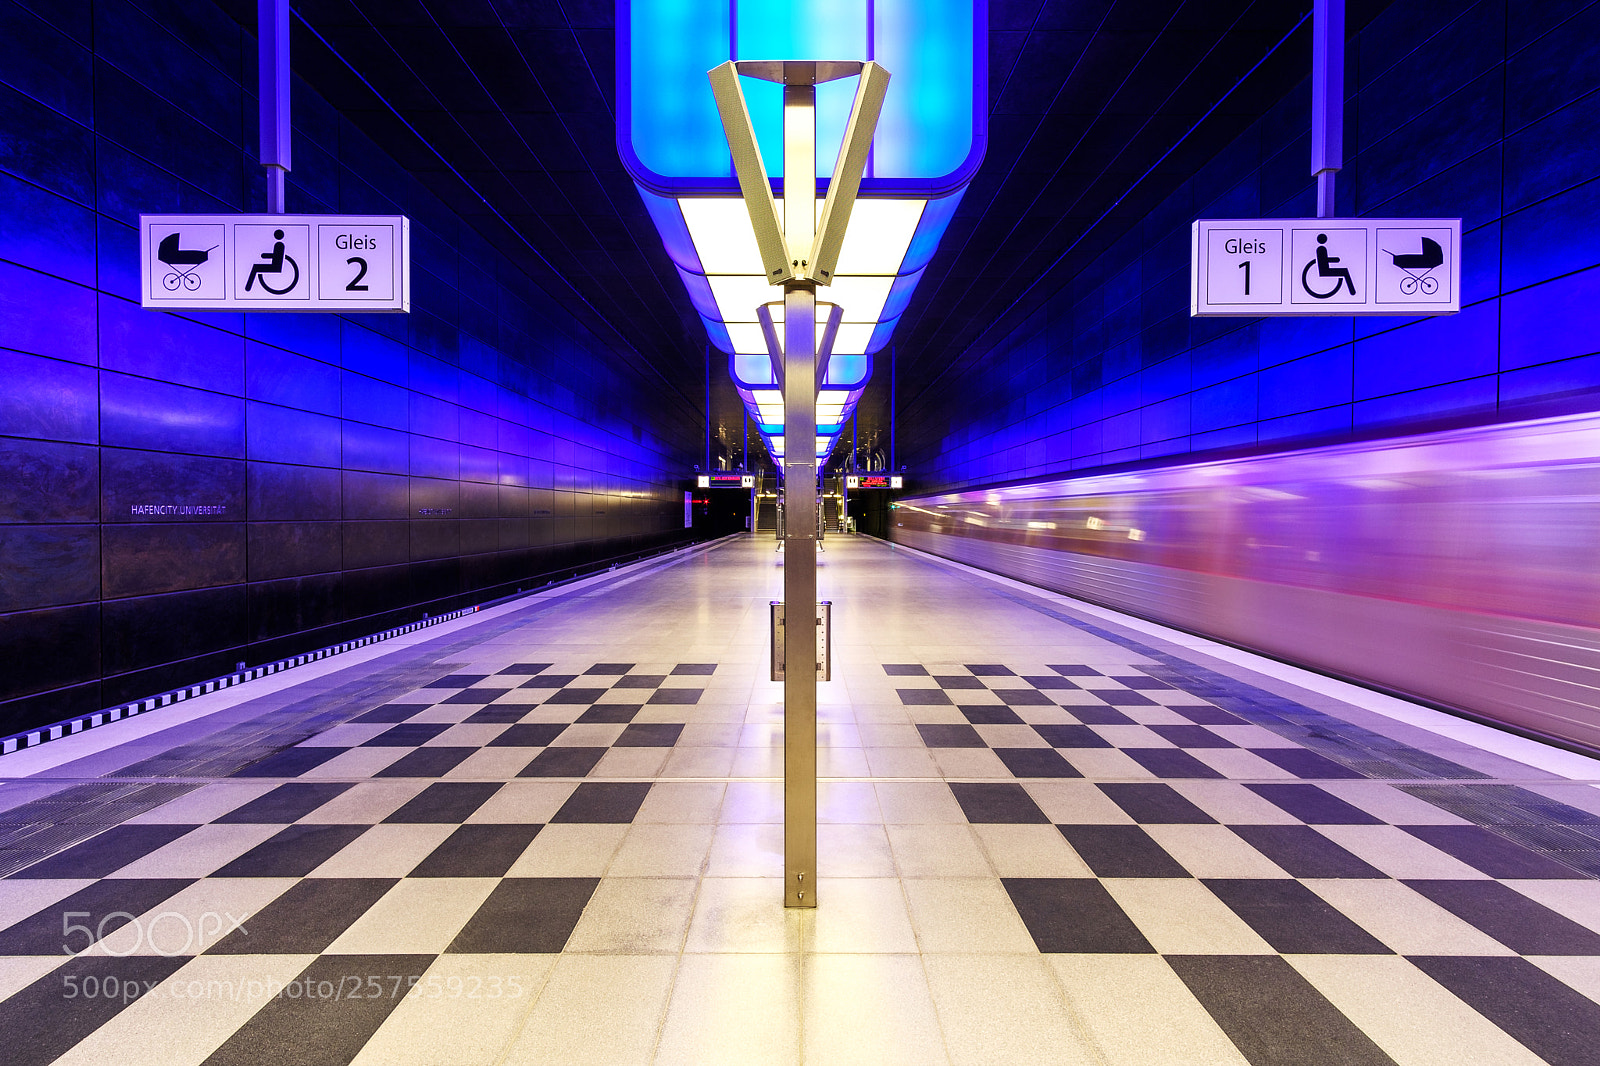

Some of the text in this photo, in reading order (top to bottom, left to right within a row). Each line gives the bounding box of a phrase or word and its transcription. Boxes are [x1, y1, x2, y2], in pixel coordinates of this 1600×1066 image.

[335, 233, 377, 250] Gleis
[1224, 237, 1266, 254] Gleis
[345, 256, 369, 292] 2
[1238, 260, 1251, 296] 1
[131, 504, 178, 515] HAFENCITY
